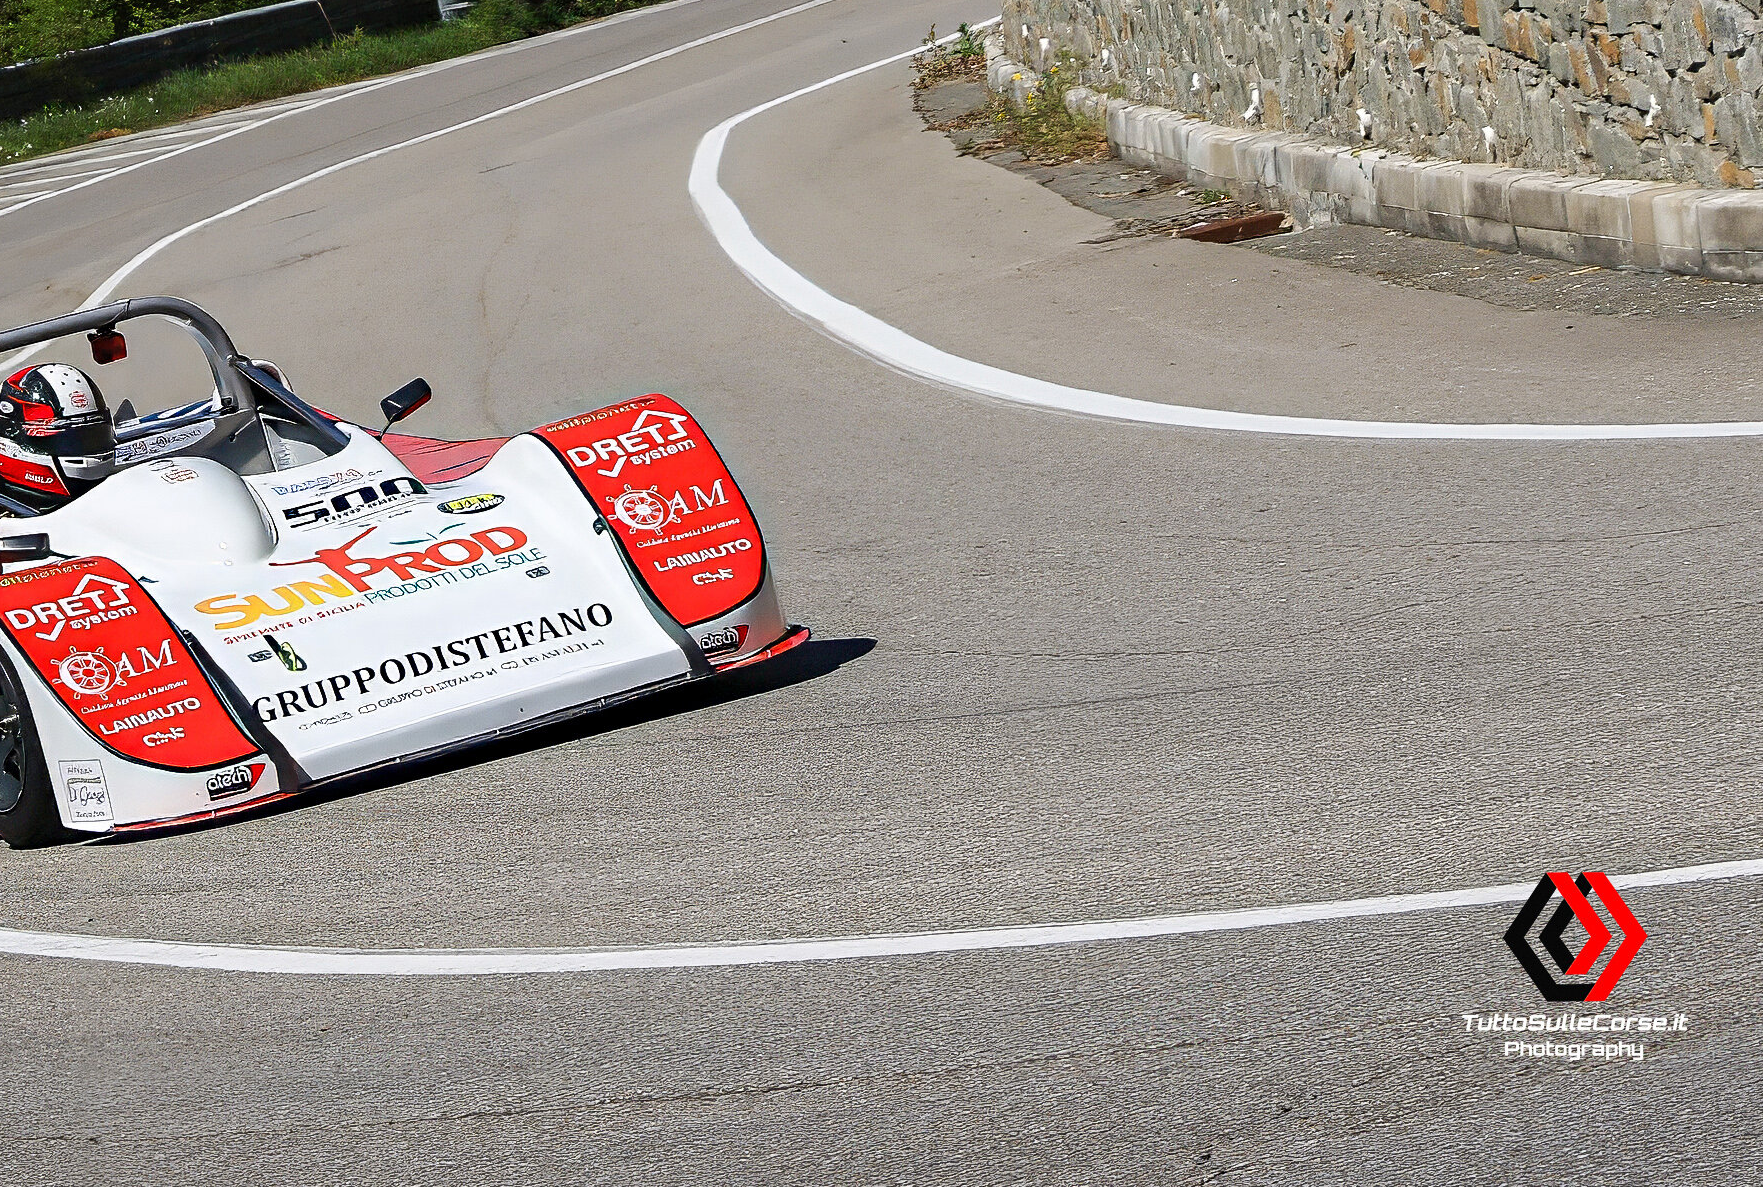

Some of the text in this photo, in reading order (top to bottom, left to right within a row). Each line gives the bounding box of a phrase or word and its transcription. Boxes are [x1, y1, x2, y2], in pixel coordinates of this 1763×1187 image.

[629, 437, 695, 466] system
[194, 526, 528, 630] SUNPROD
[364, 548, 547, 604] PRODOTTI DEL SOLE
[69, 605, 138, 630] system
[252, 603, 614, 724] GRUPPODISTEFANO
